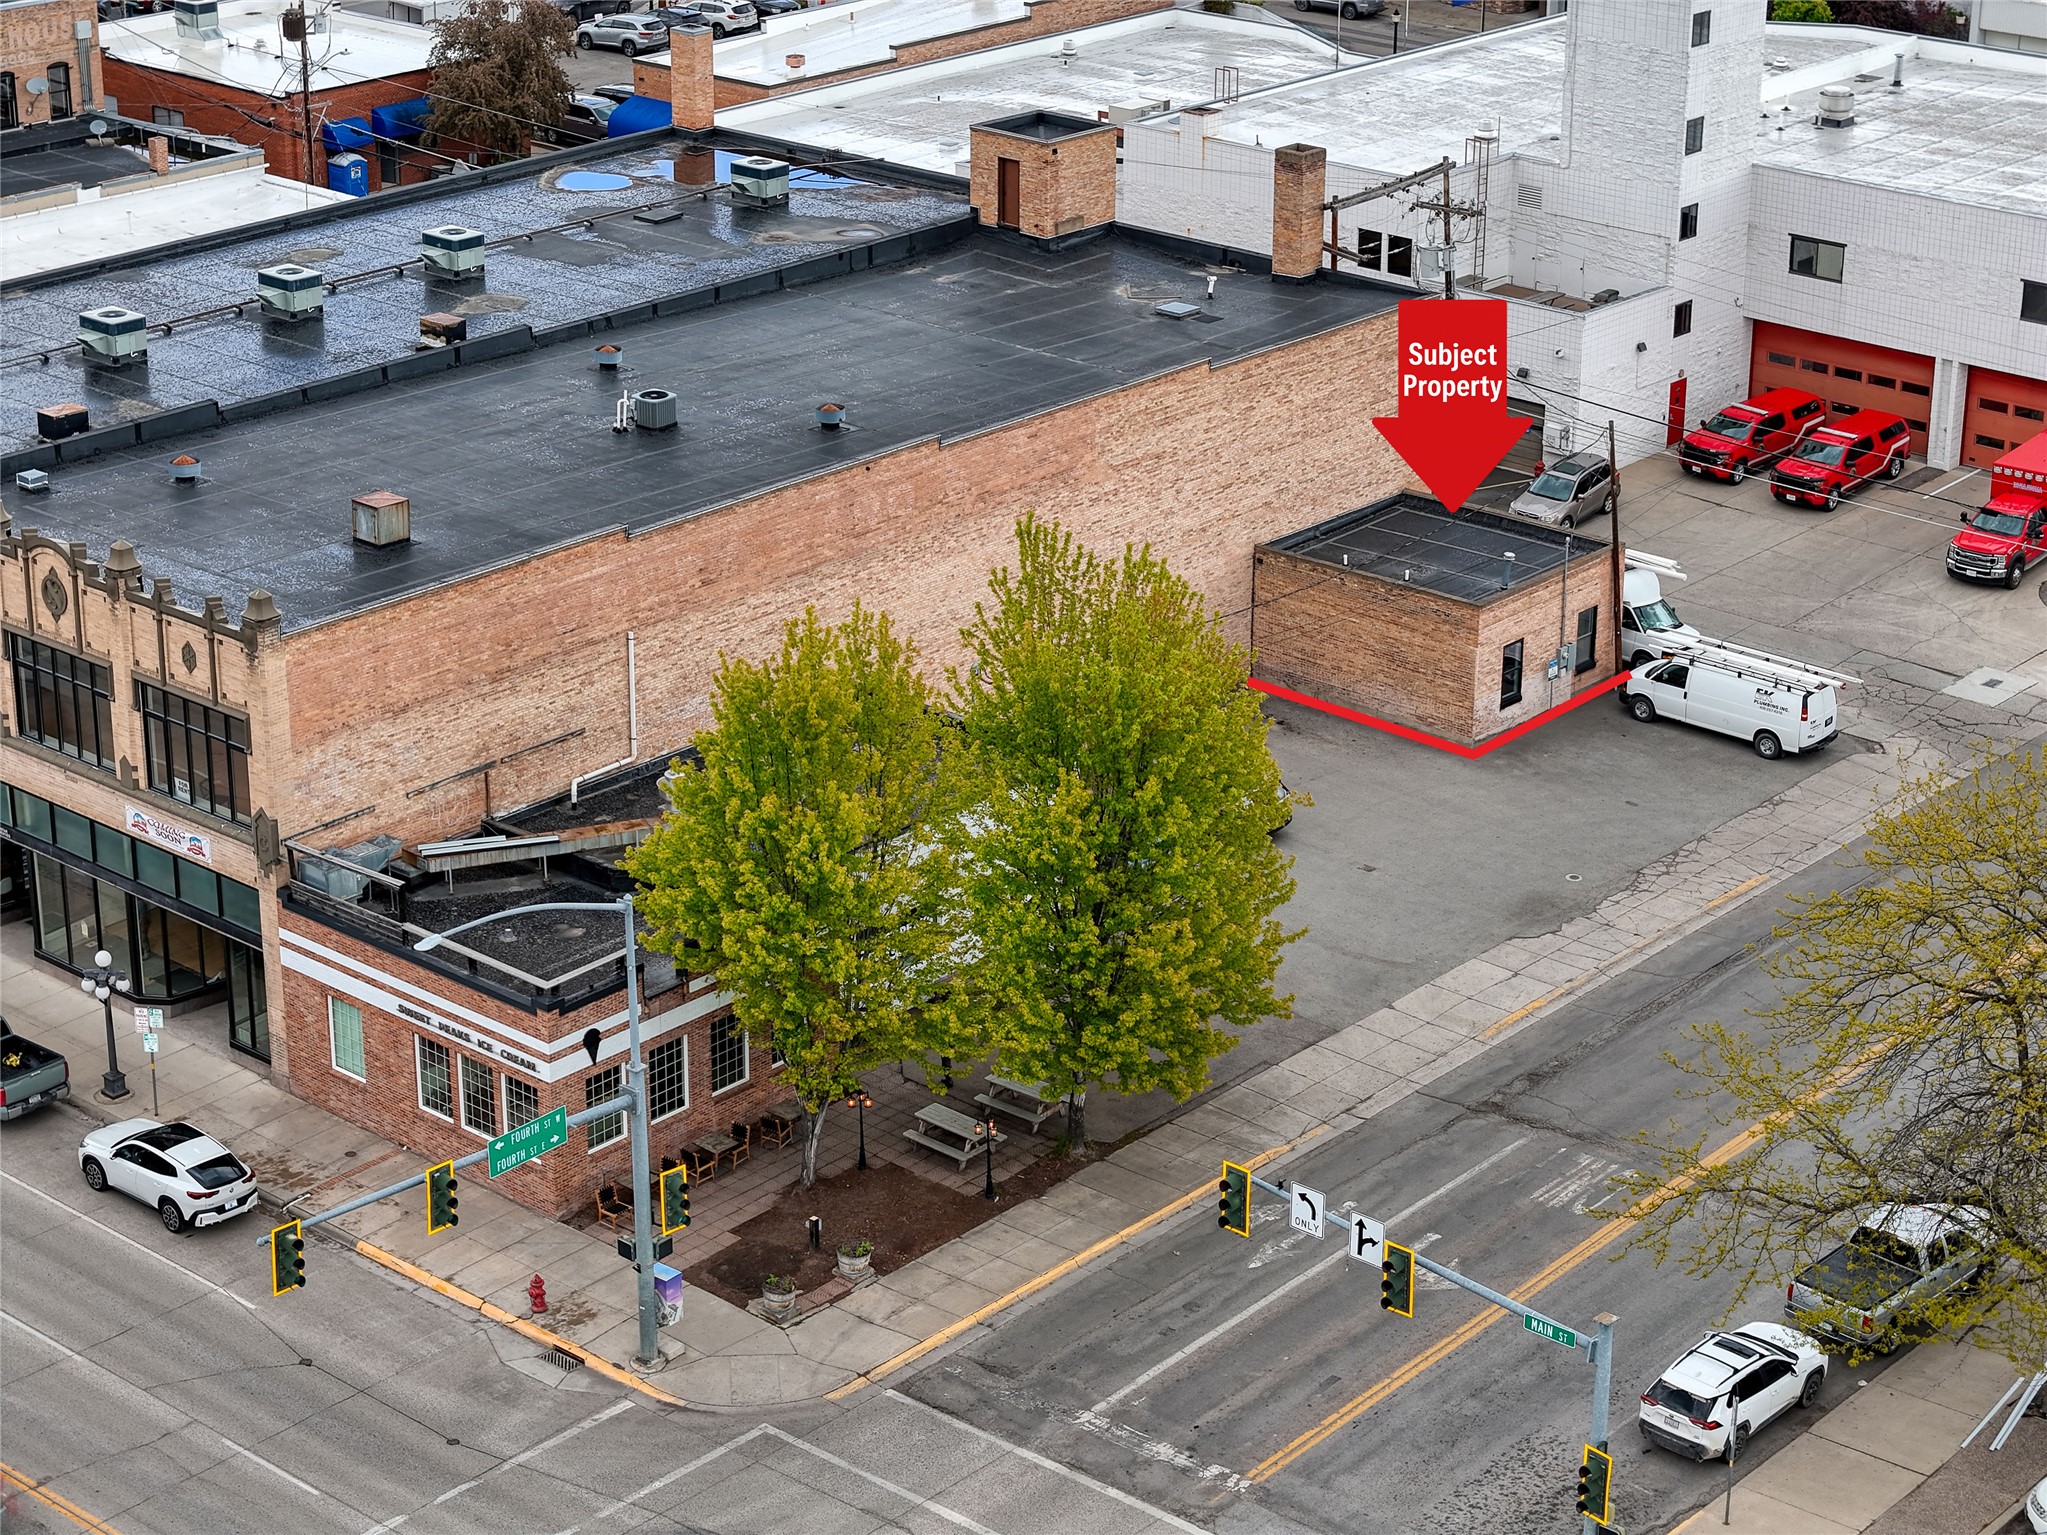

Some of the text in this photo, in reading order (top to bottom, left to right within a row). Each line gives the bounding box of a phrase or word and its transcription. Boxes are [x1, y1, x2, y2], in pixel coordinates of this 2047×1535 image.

[1753, 700, 1779, 710] PLUMBING
[147, 818, 186, 840] COMING
[155, 828, 182, 845] SOON
[397, 1003, 537, 1072] SWEET PEAKS ICE CREAM
[511, 1114, 561, 1145] FOURTH ST W
[497, 1141, 546, 1172] FOURTH ST E
[1294, 1216, 1320, 1233] ONLY
[1531, 1318, 1568, 1343] MAIN ST
